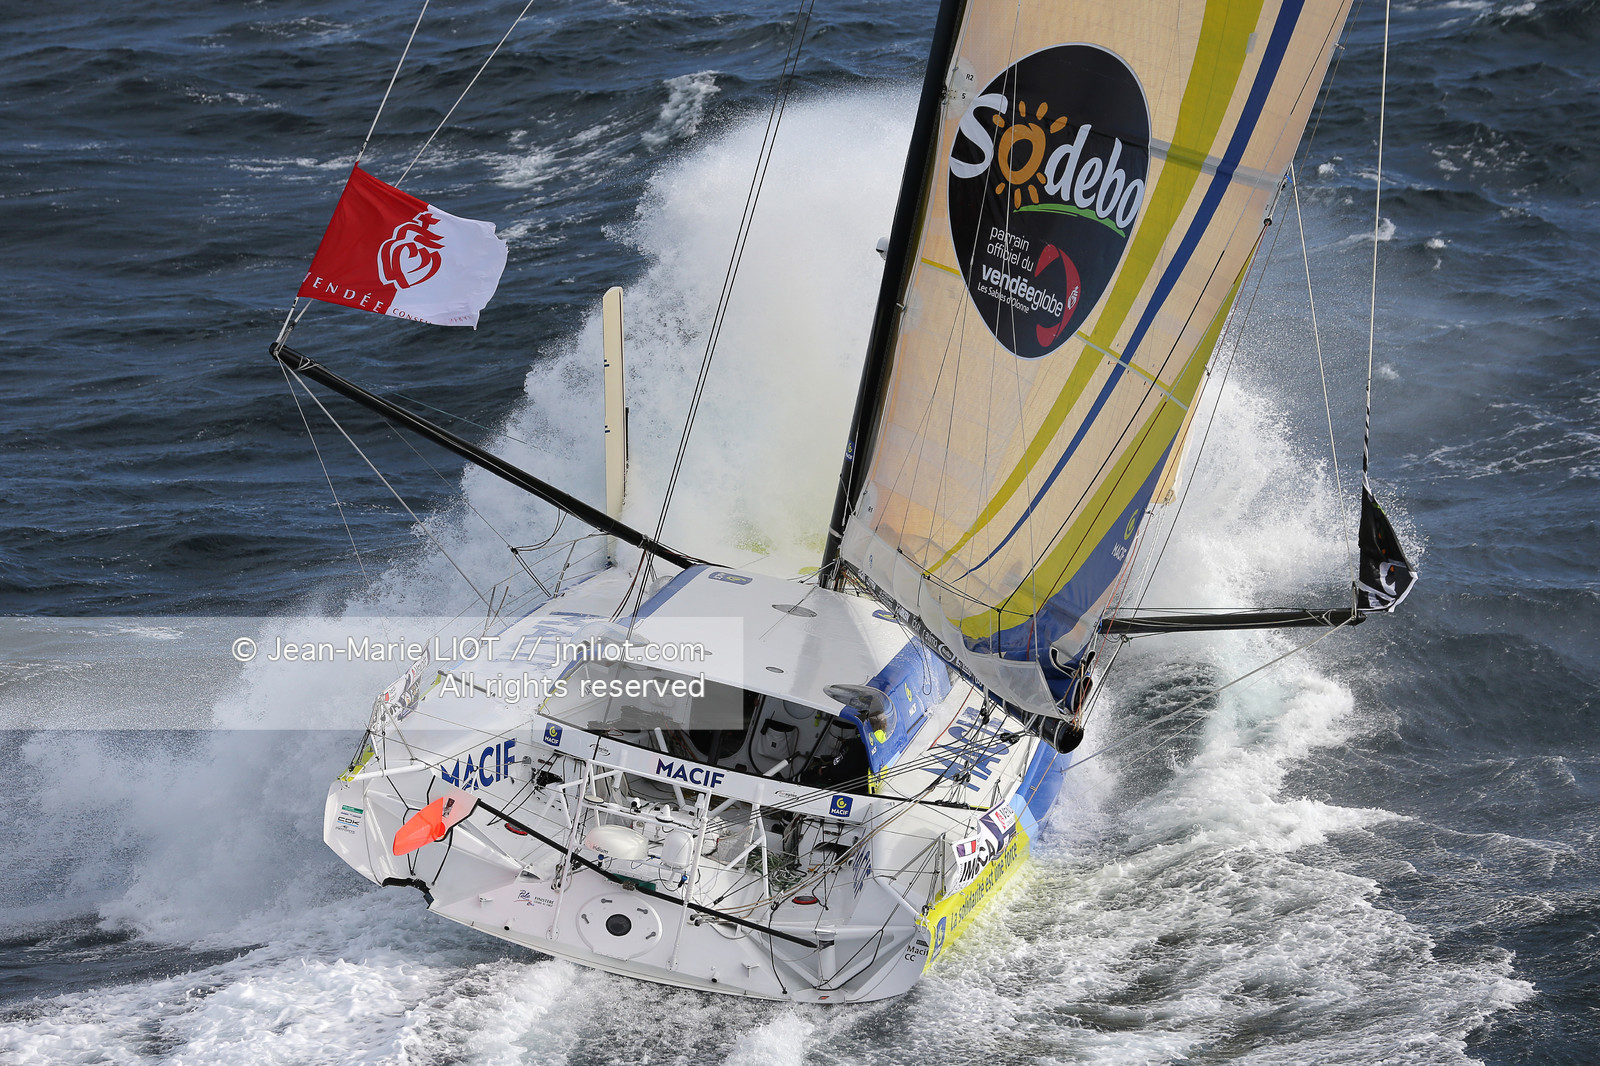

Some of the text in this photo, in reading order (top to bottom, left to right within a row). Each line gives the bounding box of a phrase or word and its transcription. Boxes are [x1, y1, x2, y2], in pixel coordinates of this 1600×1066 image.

[965, 73, 974, 81] R2
[949, 92, 1146, 230] Sodebo
[989, 226, 1030, 251] parrain
[986, 242, 1034, 272] officiel du
[977, 281, 988, 294] Les
[544, 735, 559, 746] MACIF
[440, 737, 516, 791] MACIF
[655, 757, 726, 788] MACIF
[950, 912, 959, 931] La
[1004, 841, 1018, 870] force
[904, 953, 916, 962] CC
